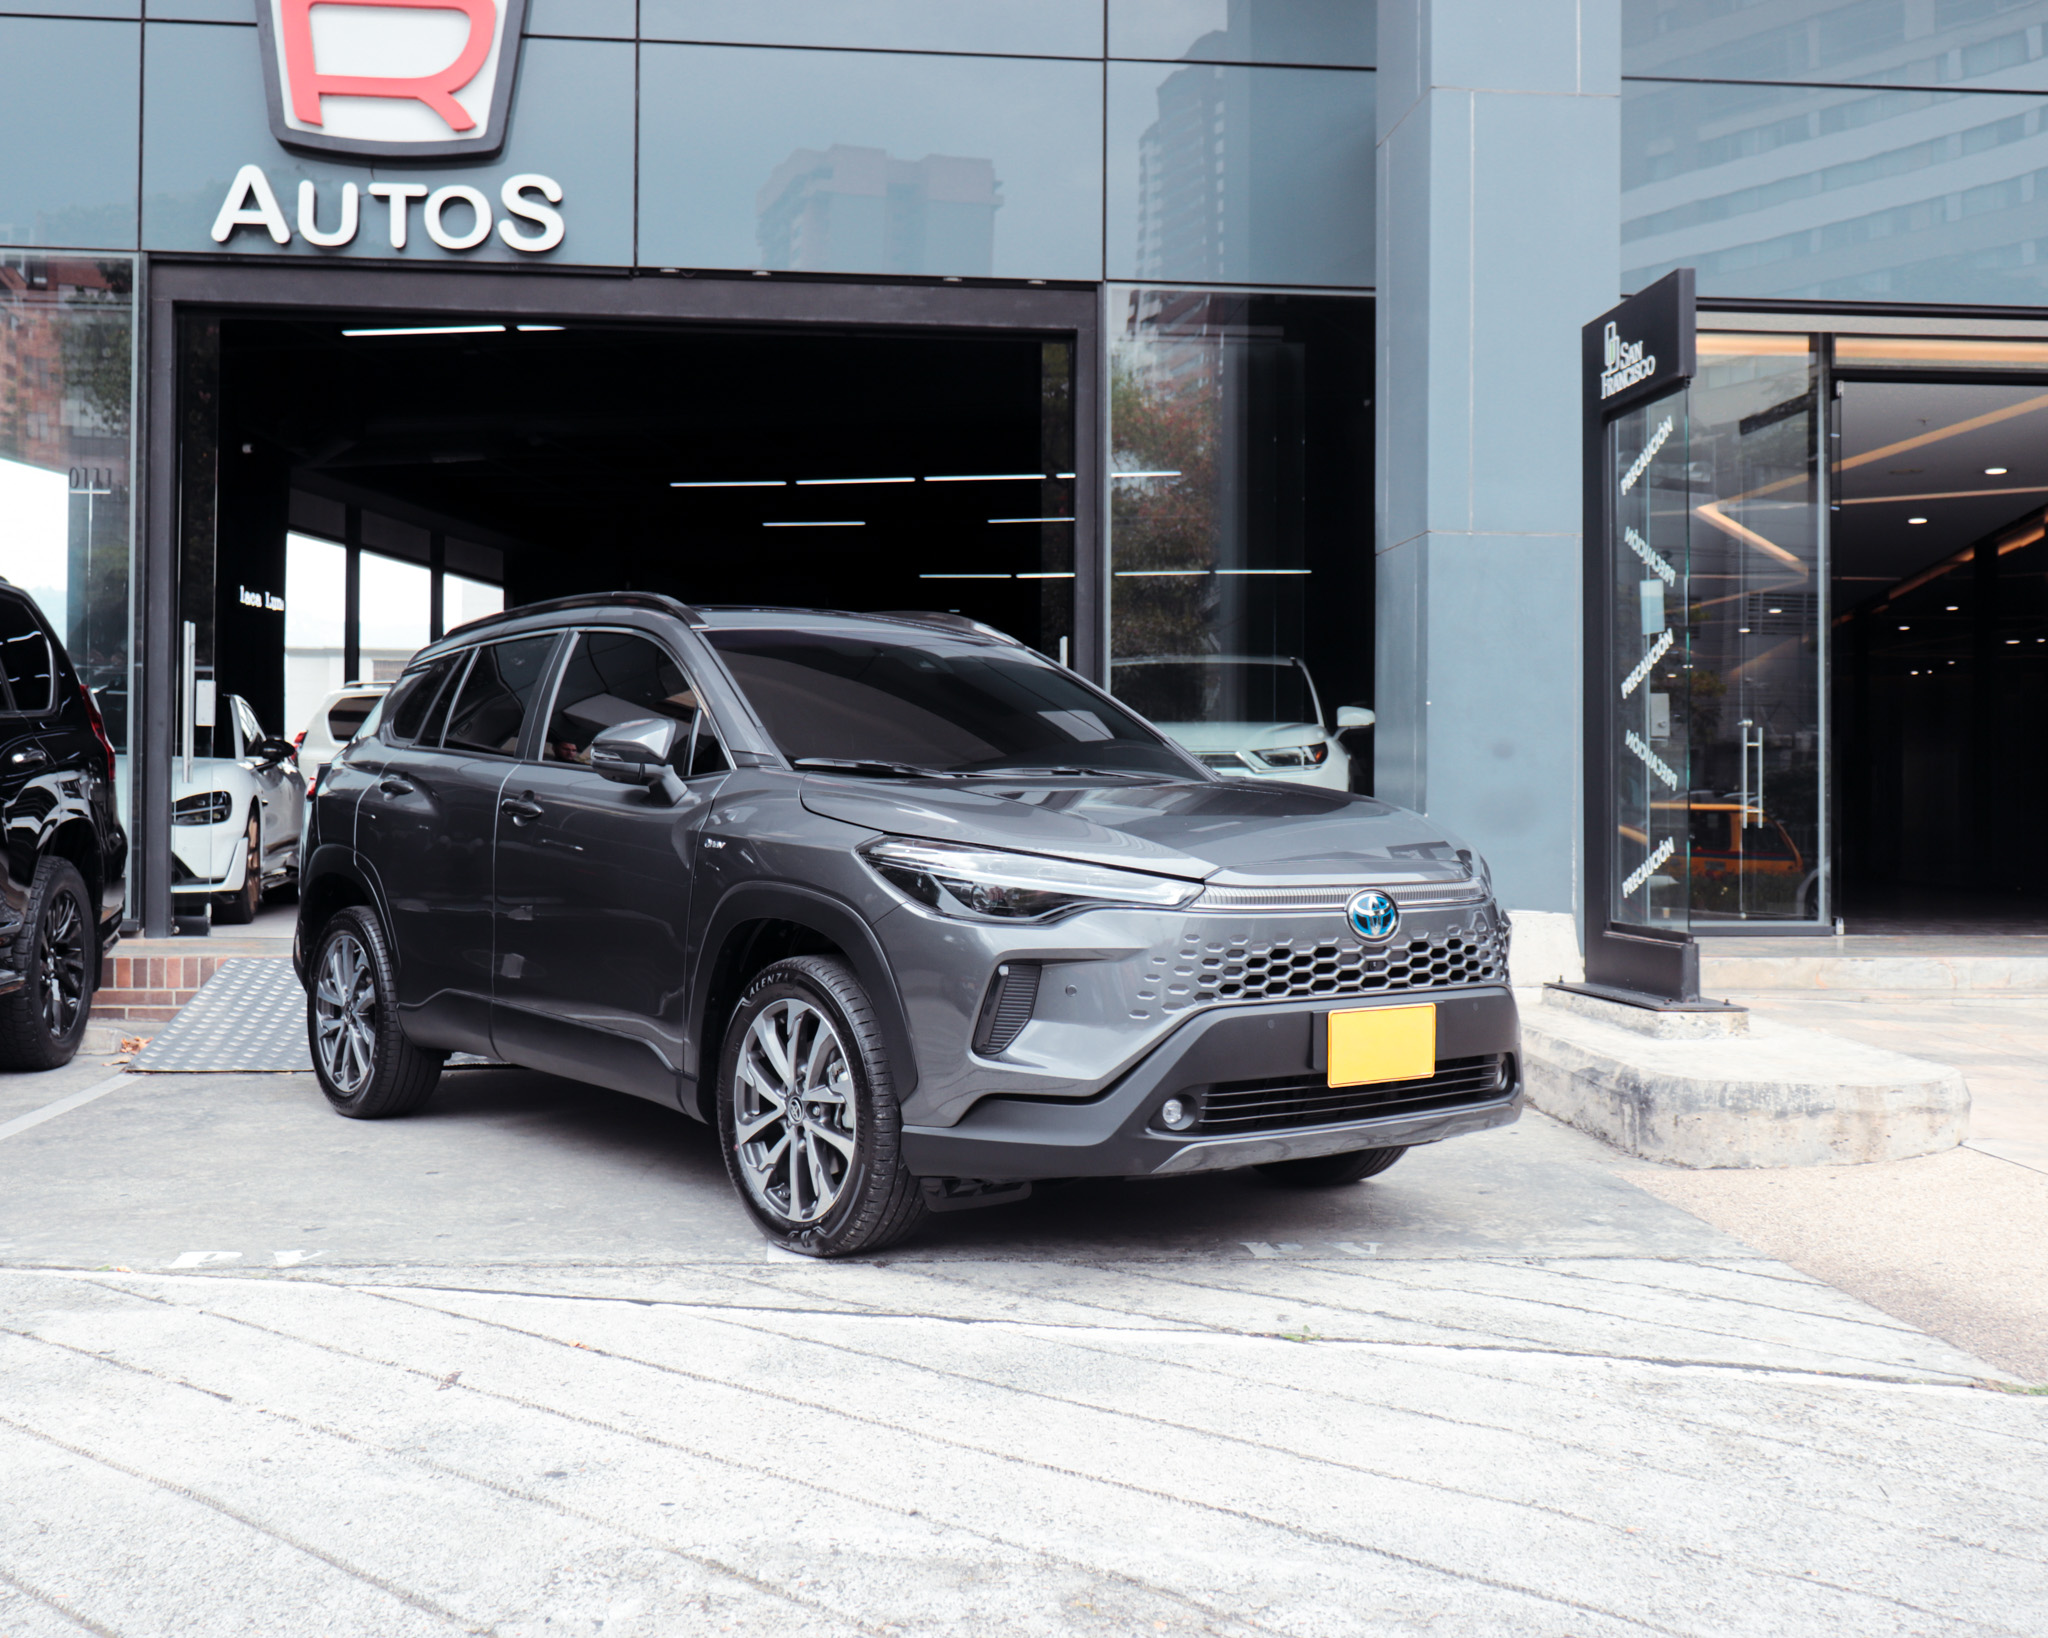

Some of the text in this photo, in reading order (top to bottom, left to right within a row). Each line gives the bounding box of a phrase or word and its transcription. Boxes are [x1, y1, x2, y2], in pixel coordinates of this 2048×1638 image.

[210, 164, 566, 253] AUTOS
[1600, 355, 1656, 400] FRANCISCO
[1620, 340, 1644, 370] SAN
[1620, 415, 1673, 496] PRECAUCIÓN
[1621, 628, 1674, 699] PRECAUCIÓN
[1622, 836, 1675, 898] PRECAUCIÓN
